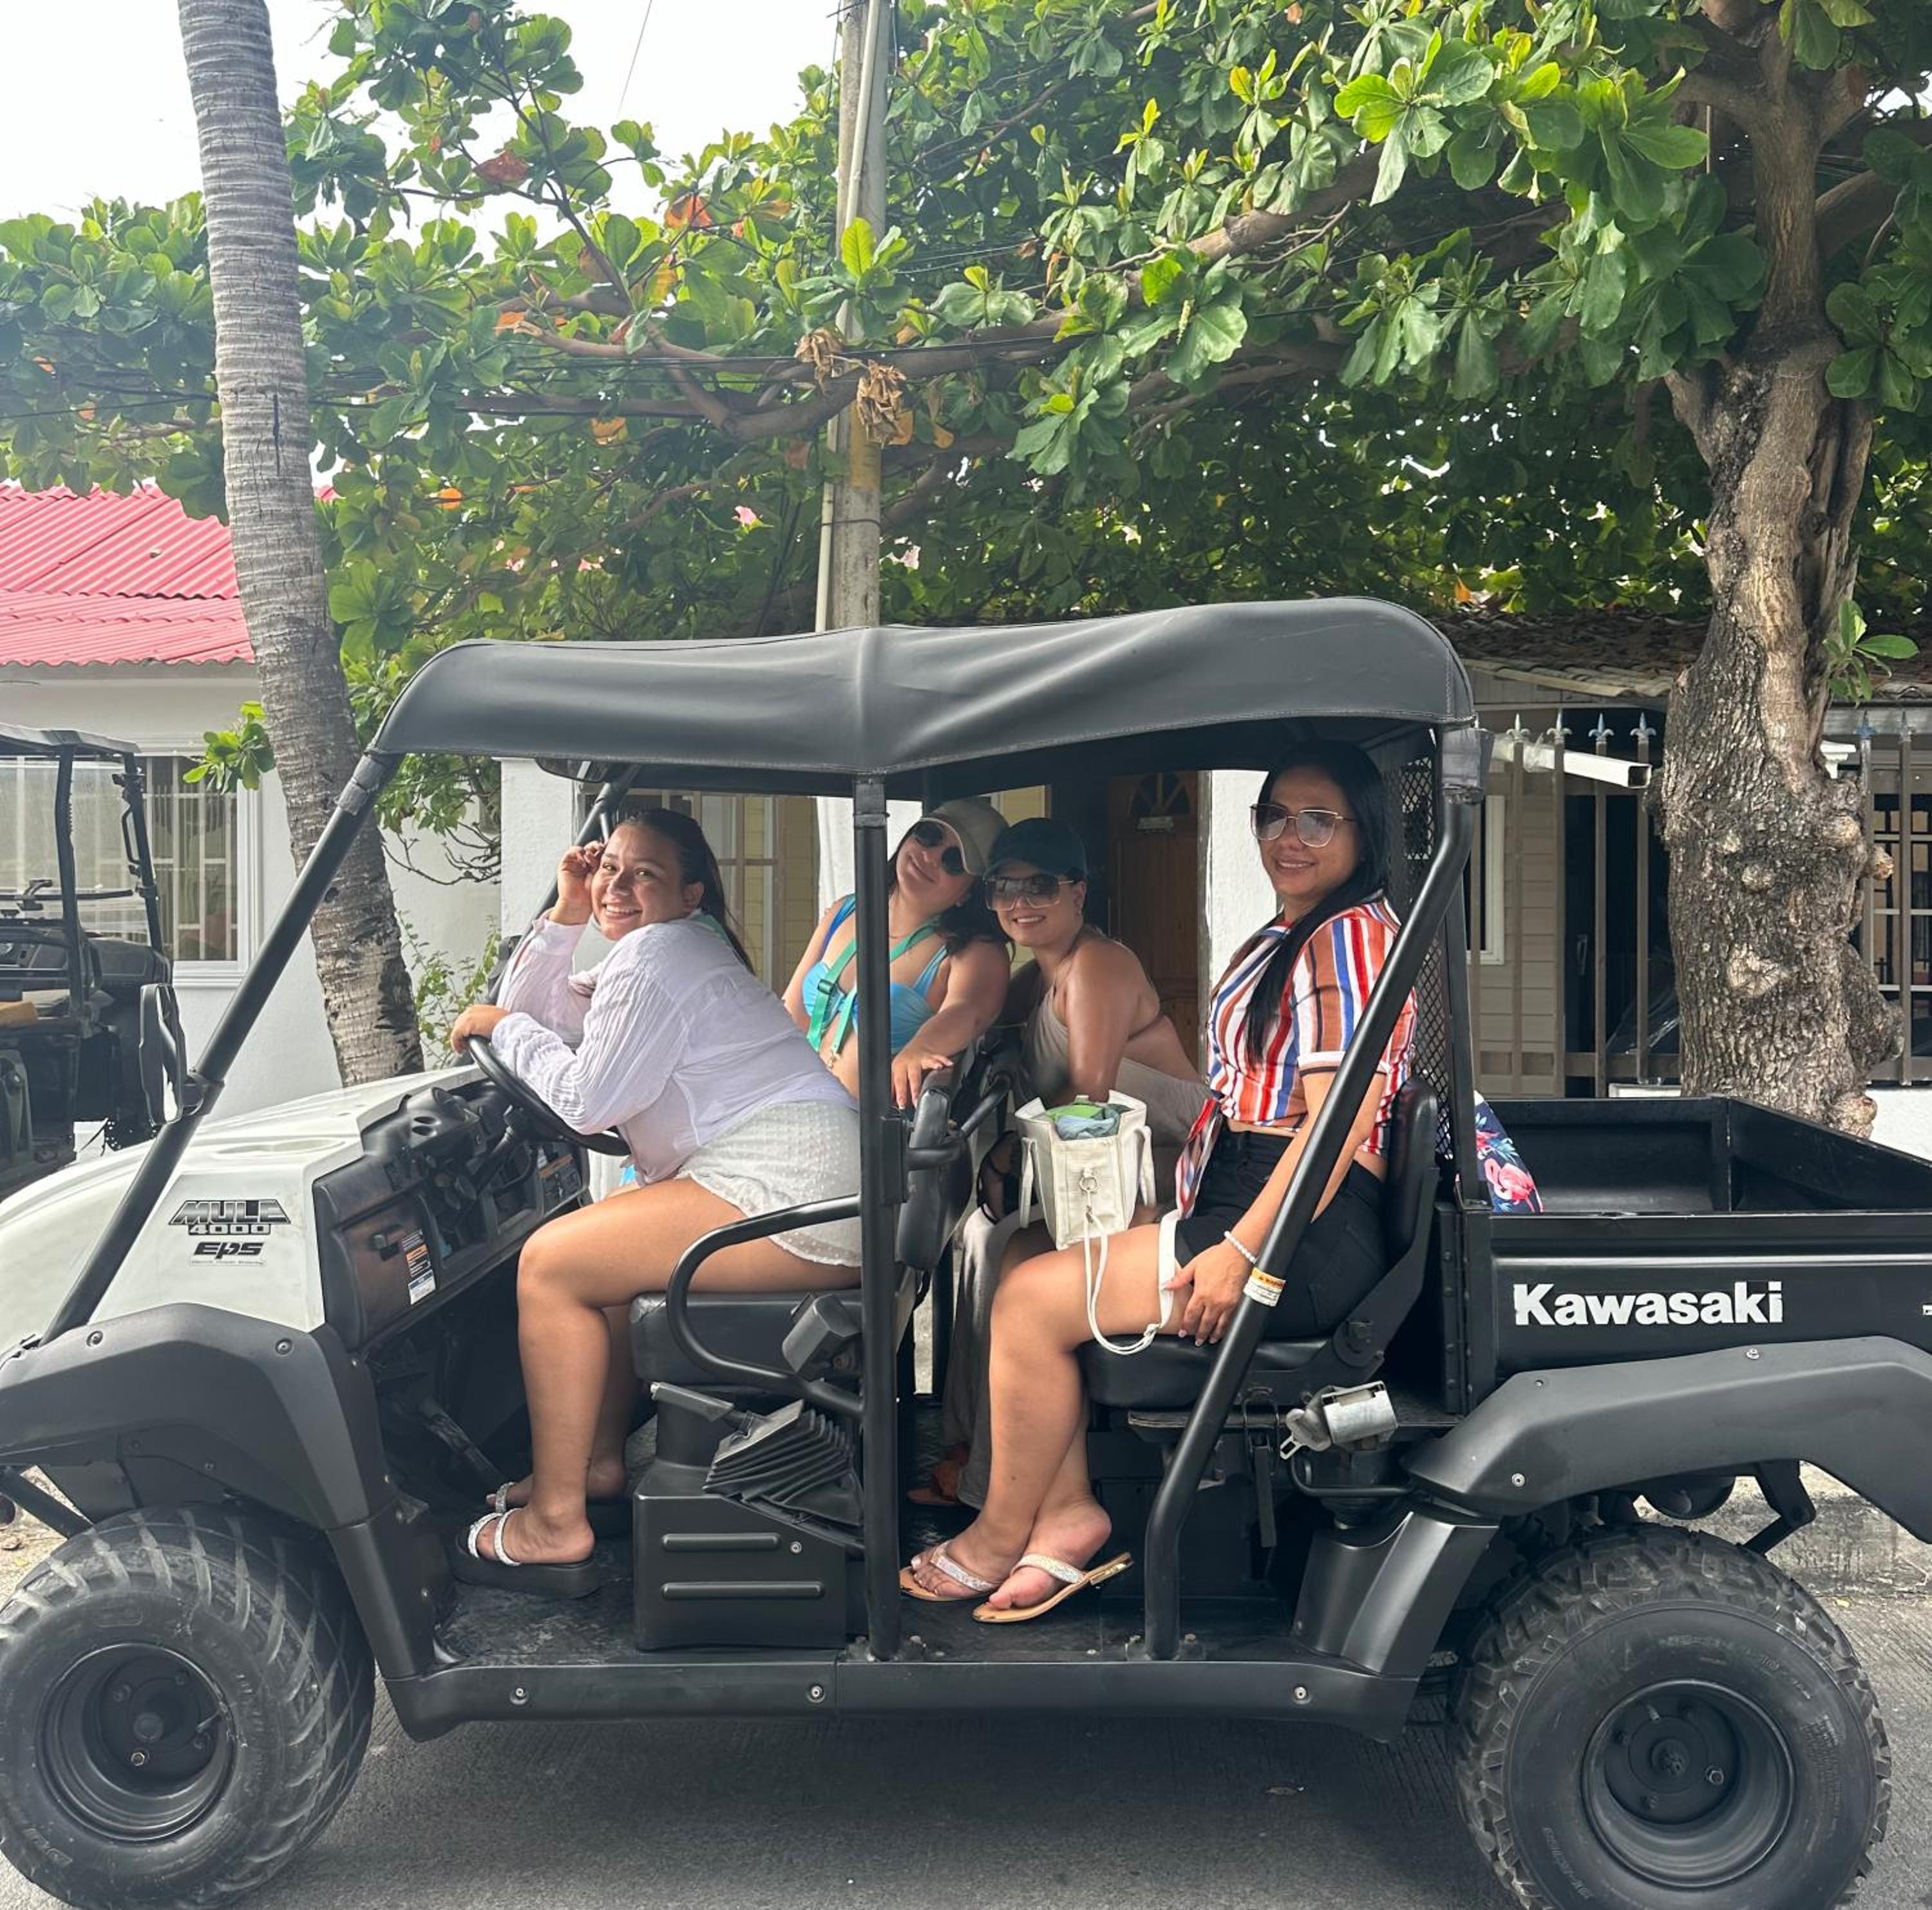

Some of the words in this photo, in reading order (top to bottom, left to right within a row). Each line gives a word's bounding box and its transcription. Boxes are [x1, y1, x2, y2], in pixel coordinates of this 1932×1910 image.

[170, 1200, 290, 1224] MULE
[189, 1224, 270, 1234] 4000
[1513, 1281, 1783, 1325] Kawasaki
